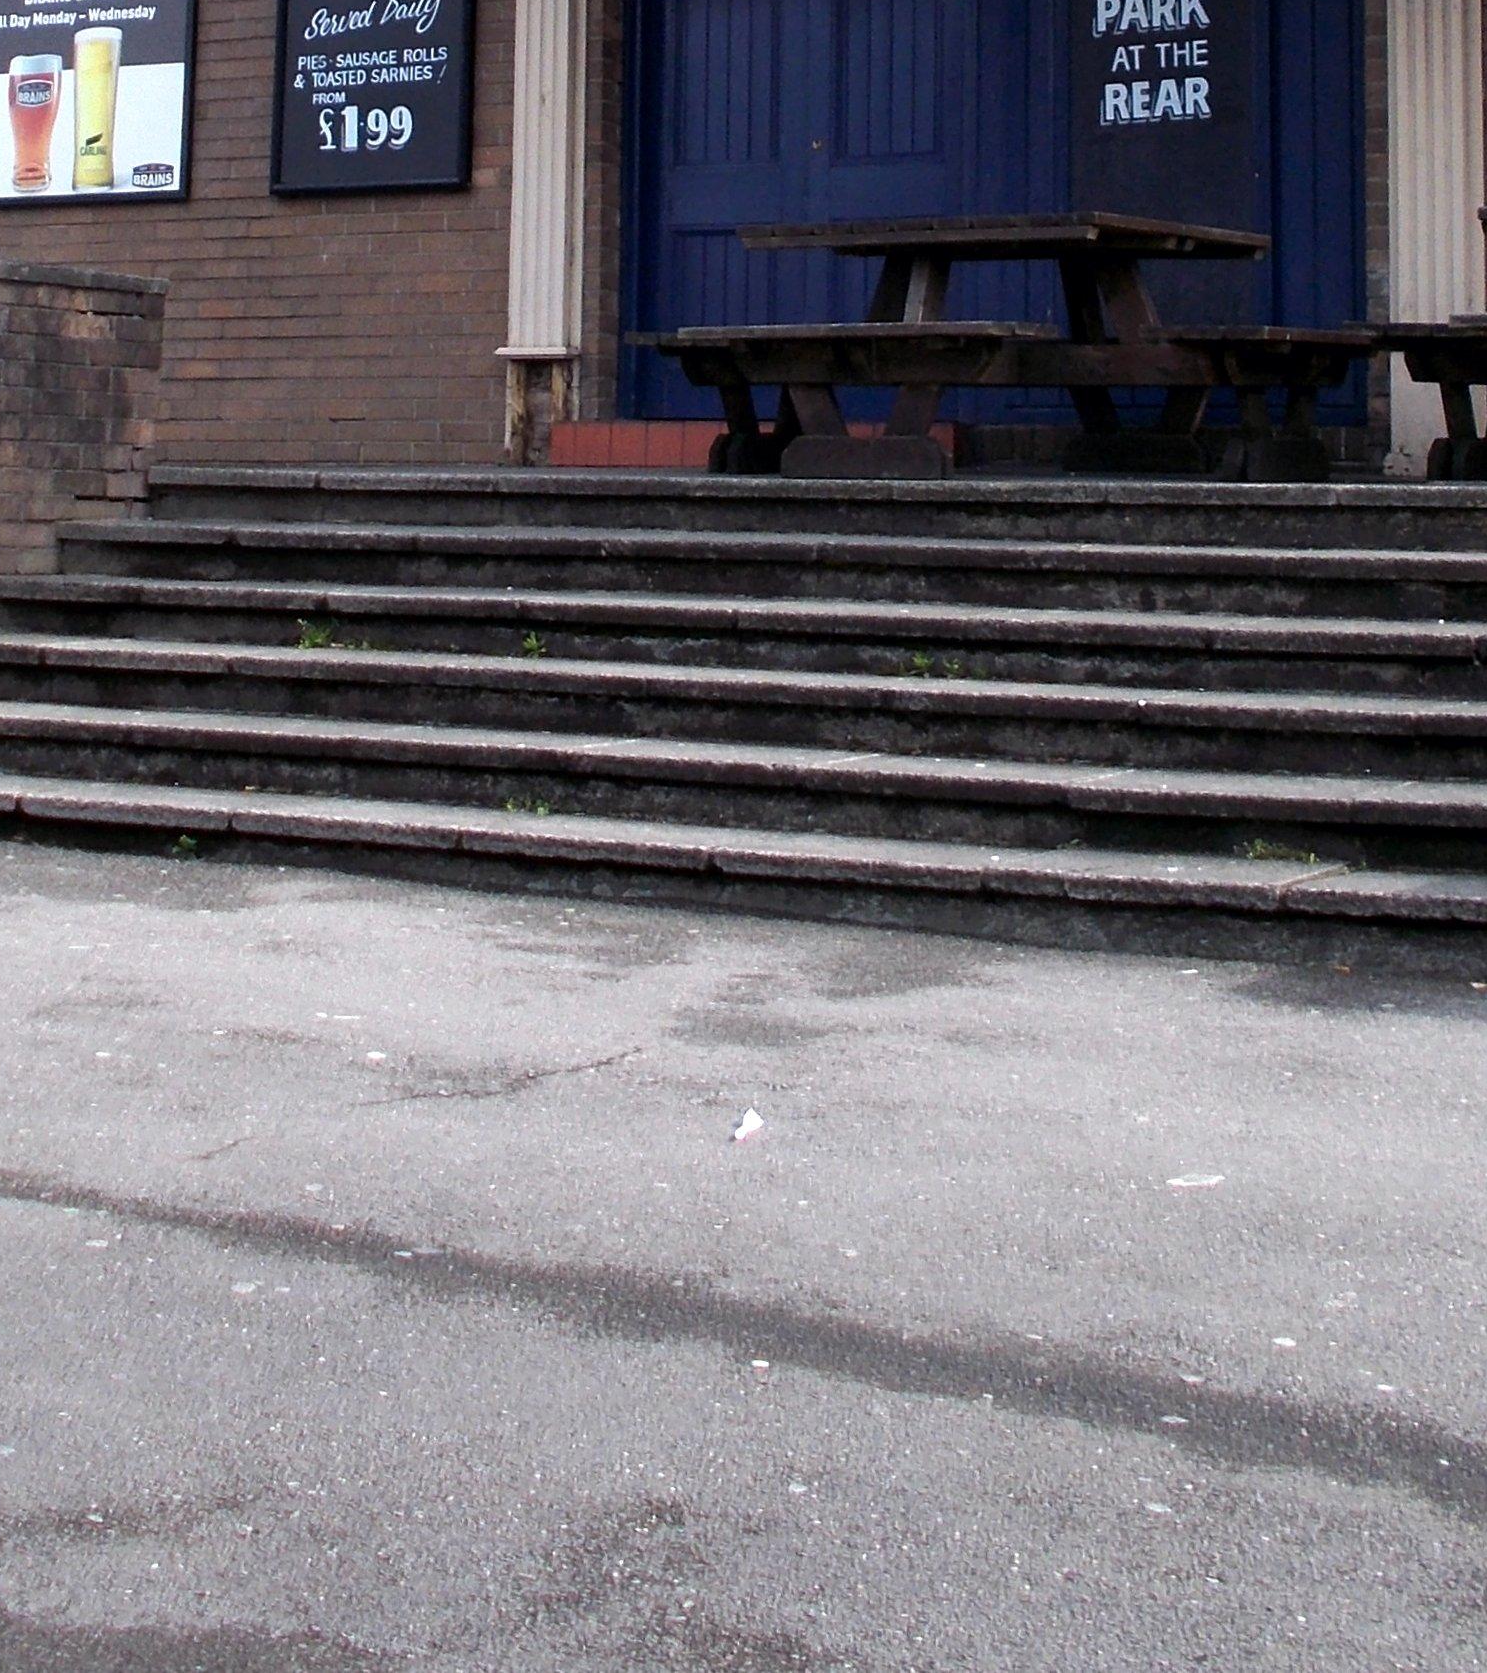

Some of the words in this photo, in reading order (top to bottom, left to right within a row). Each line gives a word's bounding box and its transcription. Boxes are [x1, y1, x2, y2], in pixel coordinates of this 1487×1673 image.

[10, 12, 32, 29] Day
[33, 11, 77, 26] Monday
[88, 5, 156, 22] Wednesday
[304, 0, 377, 40] Served
[298, 55, 327, 71] PIES
[336, 50, 397, 67] SAUSAGE
[403, 46, 448, 63] ROLLS
[1112, 45, 1145, 72] AT
[1155, 40, 1209, 68] THE
[294, 74, 305, 89] &
[312, 70, 366, 87] TOASTED
[371, 65, 433, 83] SARNIES
[18, 90, 50, 103] BRAINS
[312, 92, 346, 105] FROM
[1101, 77, 1211, 123] REAR
[133, 173, 172, 186] BRAINS
